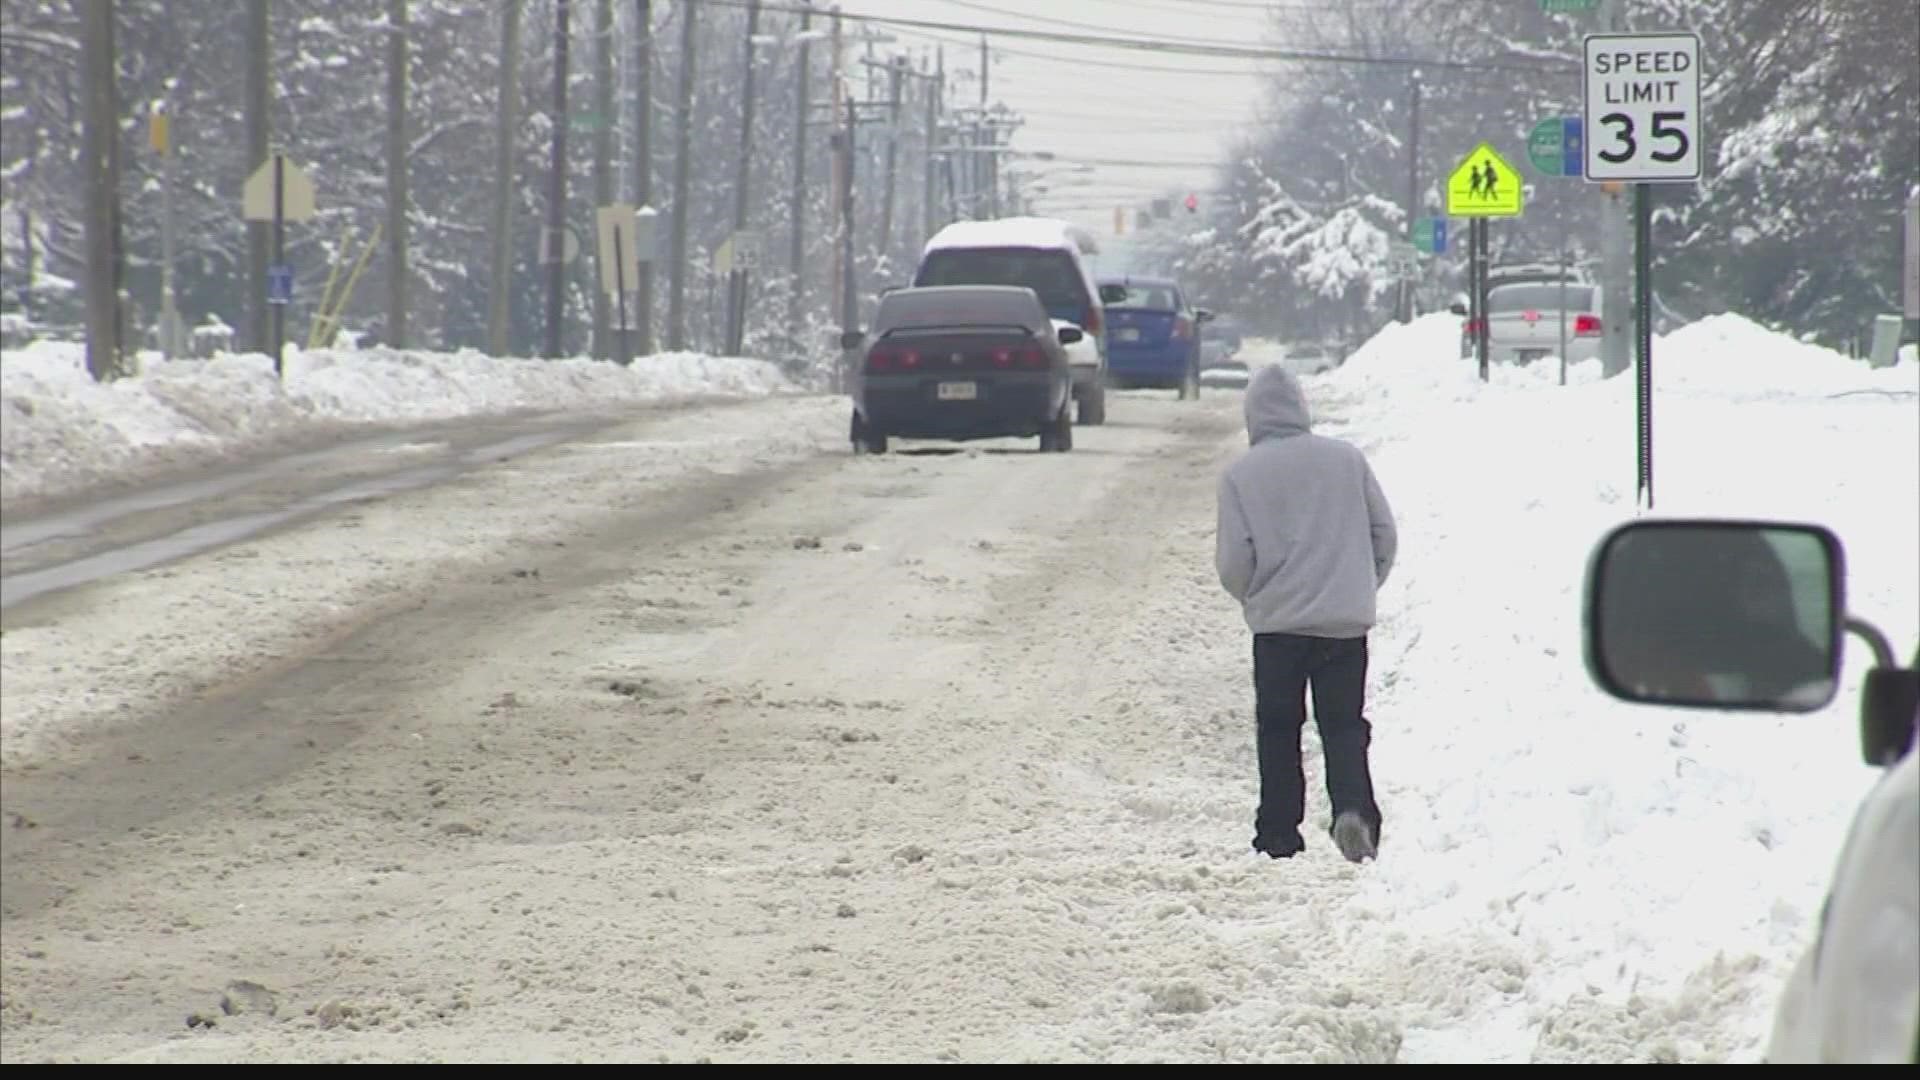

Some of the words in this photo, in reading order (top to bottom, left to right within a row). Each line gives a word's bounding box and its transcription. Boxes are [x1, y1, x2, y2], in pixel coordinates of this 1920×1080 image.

[1595, 51, 1690, 74] SPEED
[1605, 81, 1679, 103] LIMIT
[1597, 111, 1689, 164] 35
